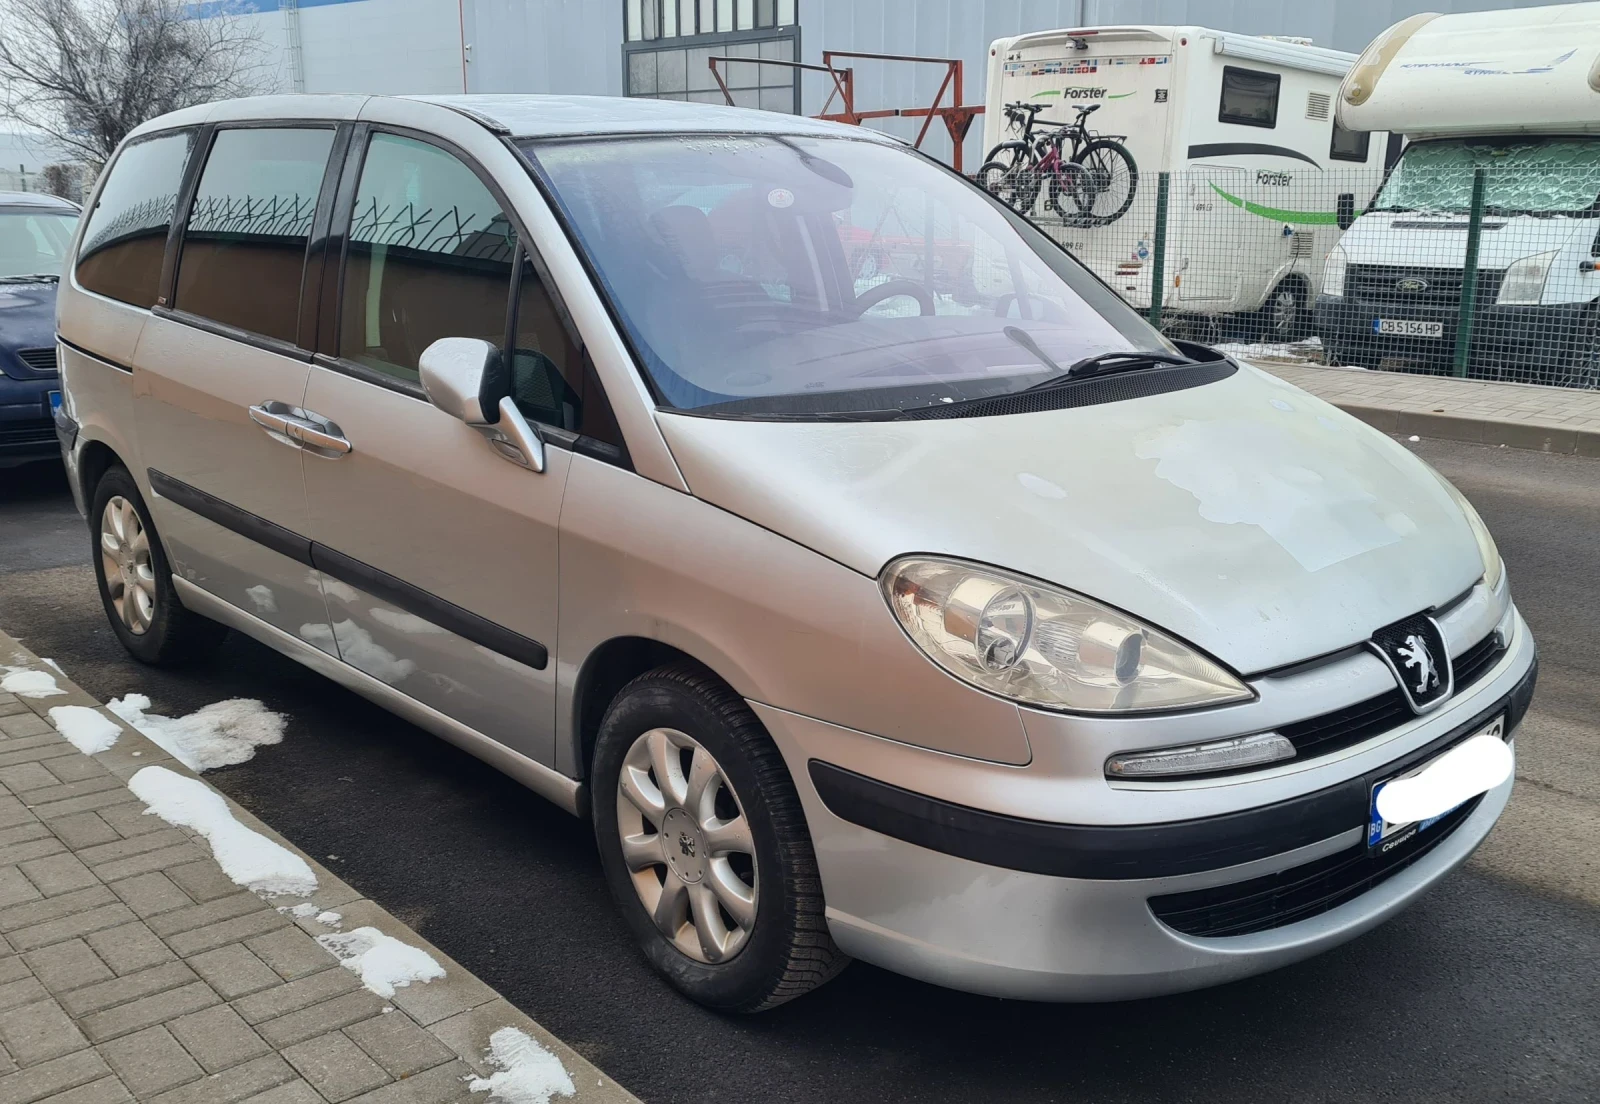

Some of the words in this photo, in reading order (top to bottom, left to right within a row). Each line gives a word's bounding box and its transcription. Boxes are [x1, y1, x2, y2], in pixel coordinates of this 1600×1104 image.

[1064, 87, 1107, 99] Forster
[1256, 171, 1293, 186] Forster
[1381, 320, 1395, 332] CB
[1397, 321, 1423, 334] 5156
[1425, 323, 1440, 335] HP
[1370, 820, 1381, 836] BG
